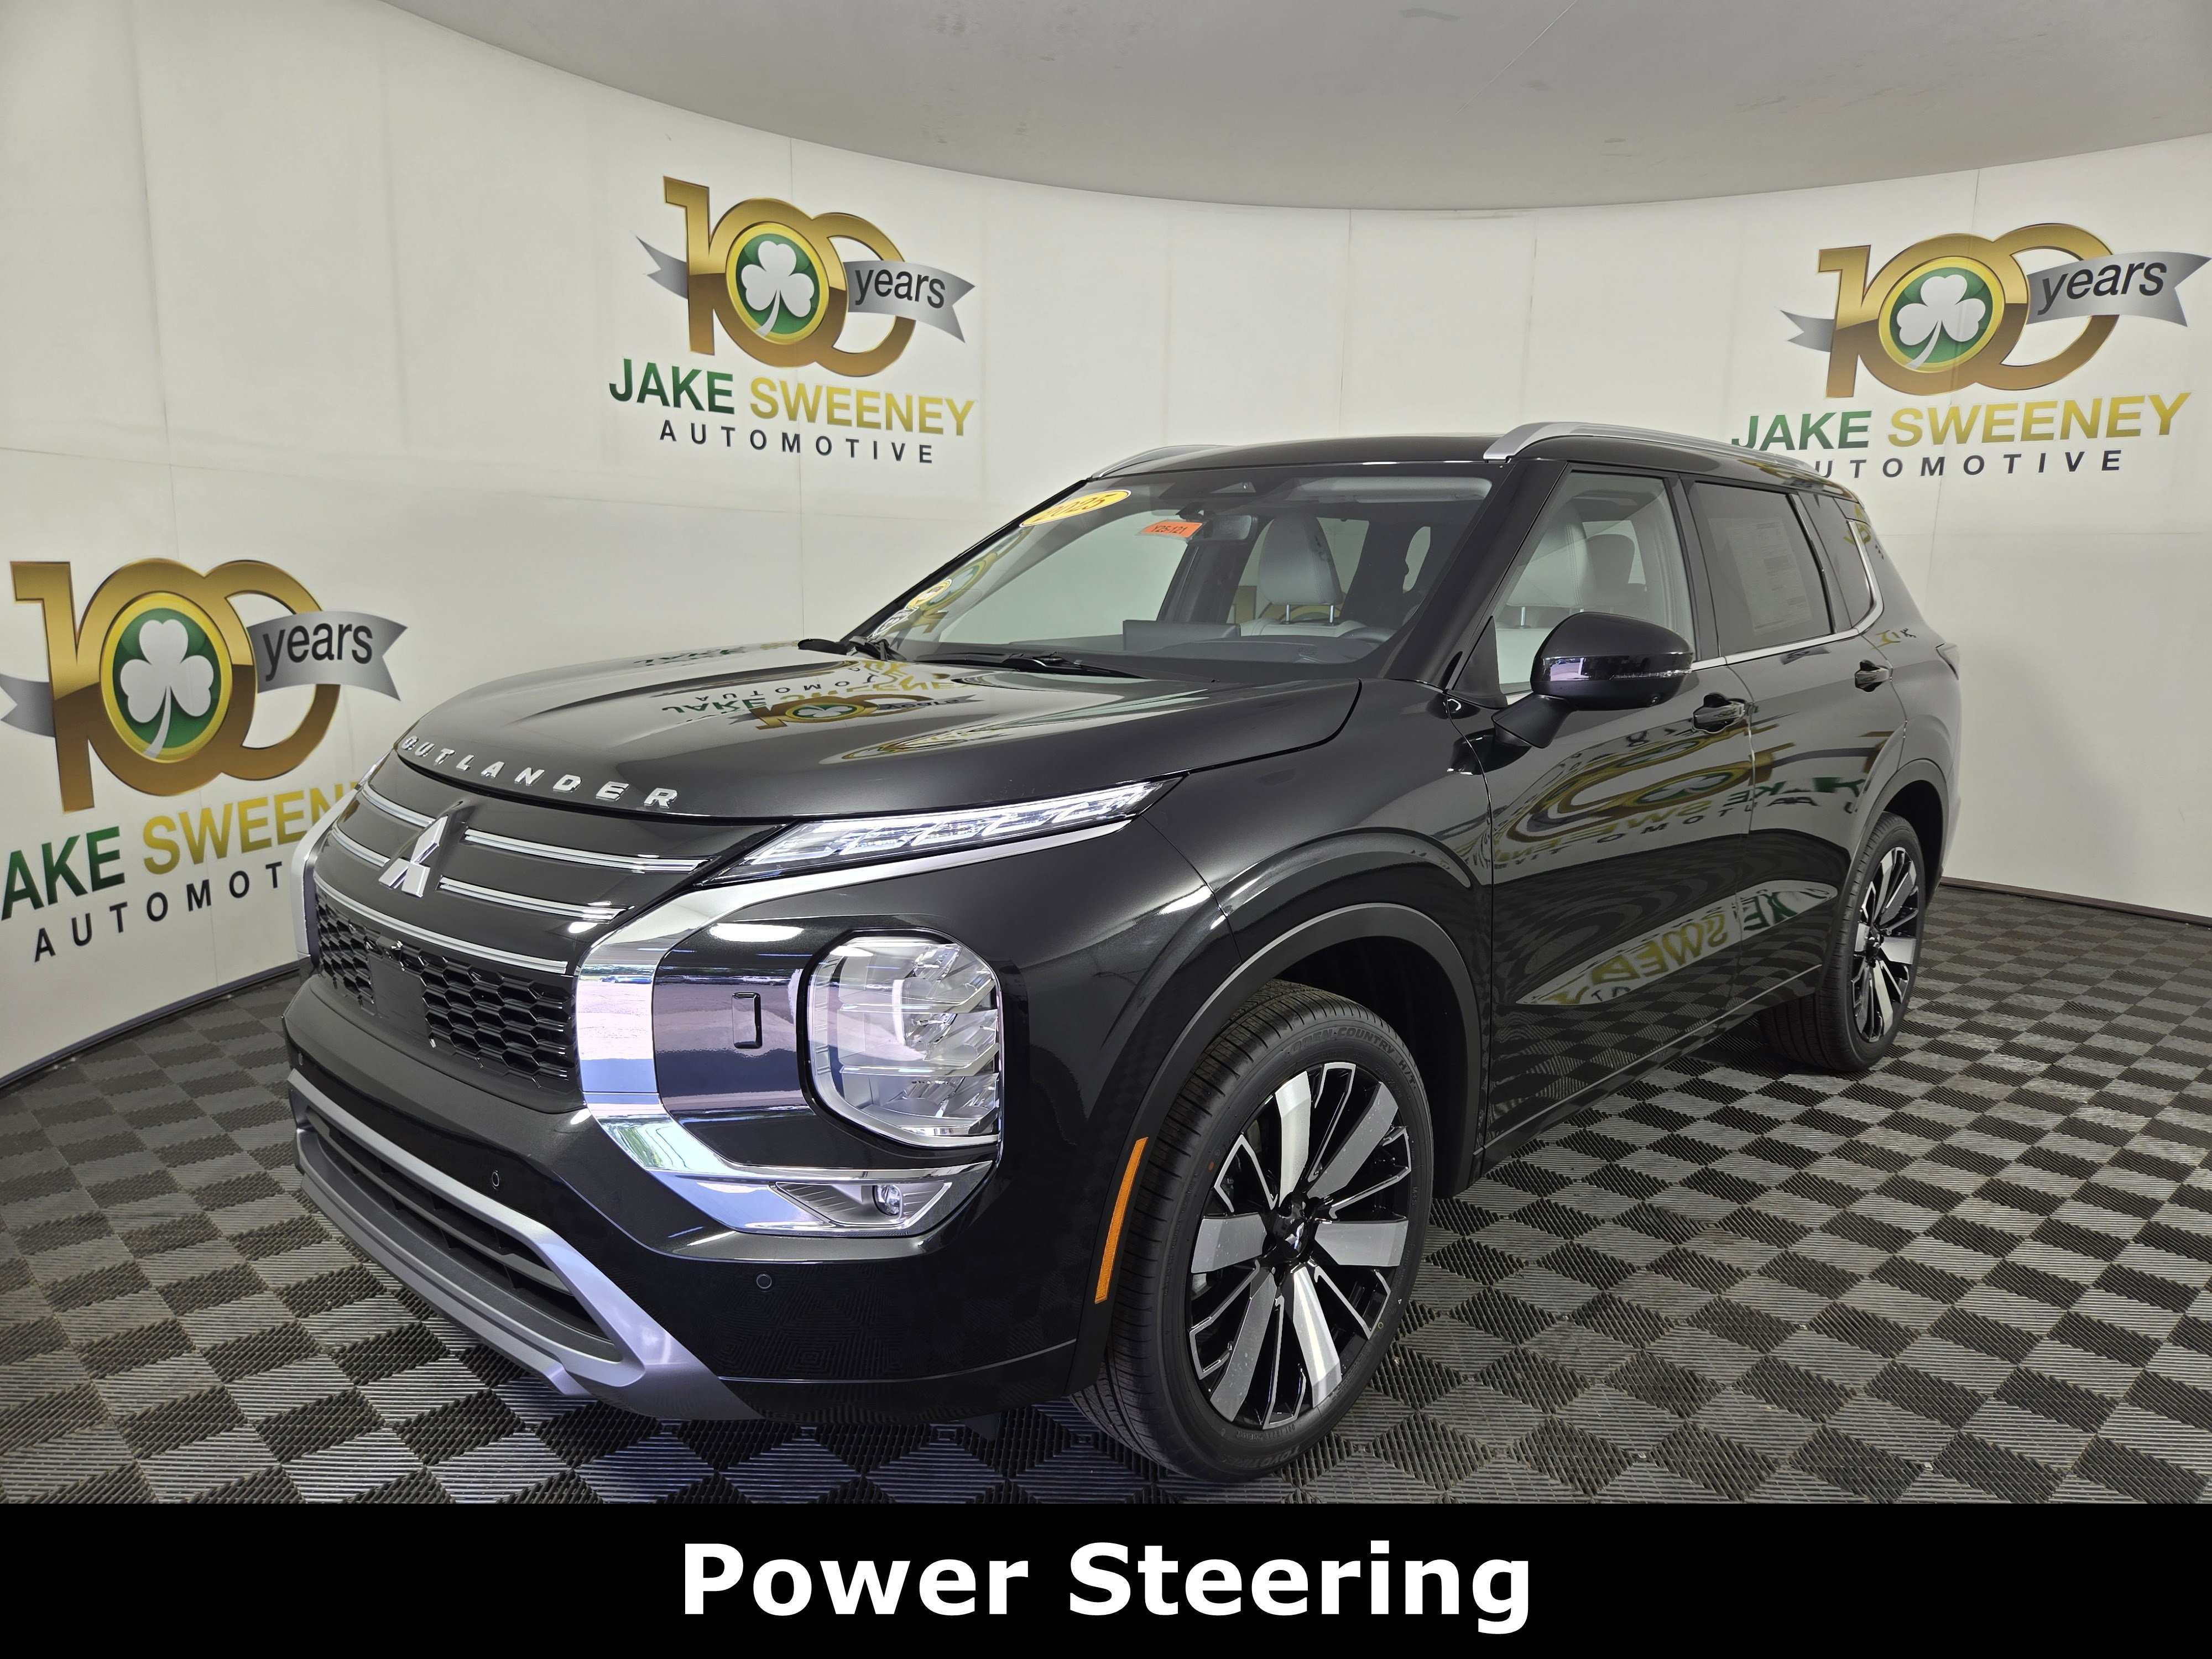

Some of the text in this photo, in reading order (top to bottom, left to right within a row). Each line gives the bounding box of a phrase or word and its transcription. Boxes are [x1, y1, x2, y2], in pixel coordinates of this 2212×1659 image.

[663, 175, 946, 377] 100 years
[1817, 223, 2167, 399] 100 years
[608, 357, 975, 436] JAKE SWEENEY
[1731, 392, 2192, 451] JAKE SWEENEY
[660, 419, 932, 463] AUTOMOTIVE
[1814, 449, 2122, 479] UTOMOTIVE
[1031, 493, 1119, 523] 2025
[1153, 525, 1189, 535] Y25-121
[9, 557, 373, 815] 100 years
[401, 735, 679, 808] OUTLANDER
[1, 781, 358, 921] AKE SWEEN
[34, 861, 282, 962] AUTOMOT
[1291, 1029, 1333, 1052] OPEN
[1337, 1027, 1395, 1054] COUNTRY
[1398, 1060, 1417, 1084] H/T
[1260, 1445, 1300, 1467] TOYO
